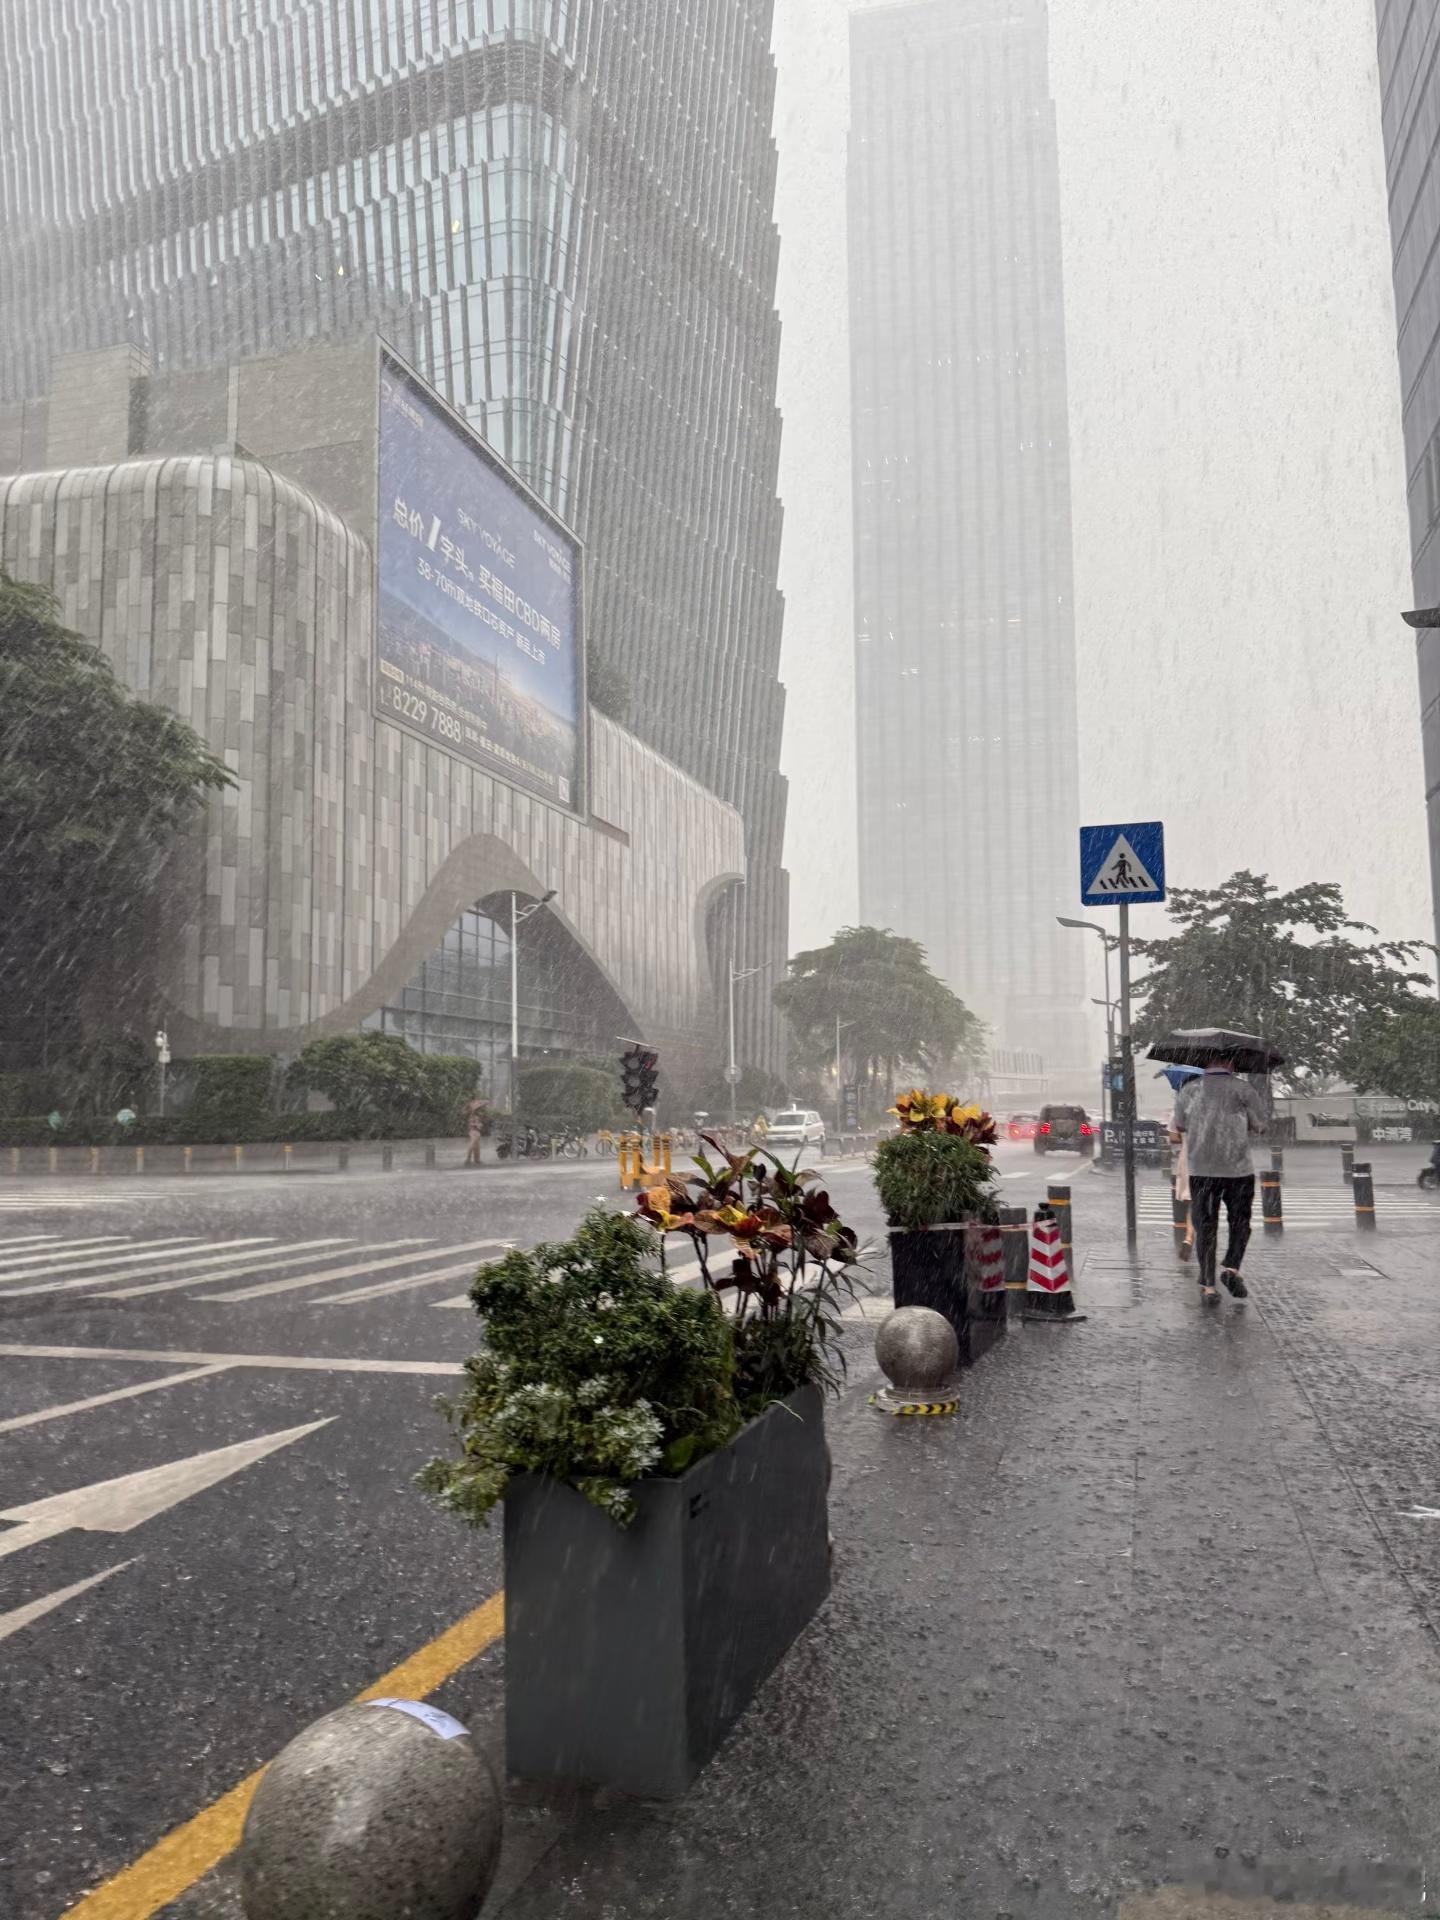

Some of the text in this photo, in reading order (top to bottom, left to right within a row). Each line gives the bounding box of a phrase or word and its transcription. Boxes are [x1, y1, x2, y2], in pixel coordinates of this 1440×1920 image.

[392, 685, 427, 723] 8229
[431, 706, 462, 744] 7888
[1407, 1099, 1430, 1114] City
